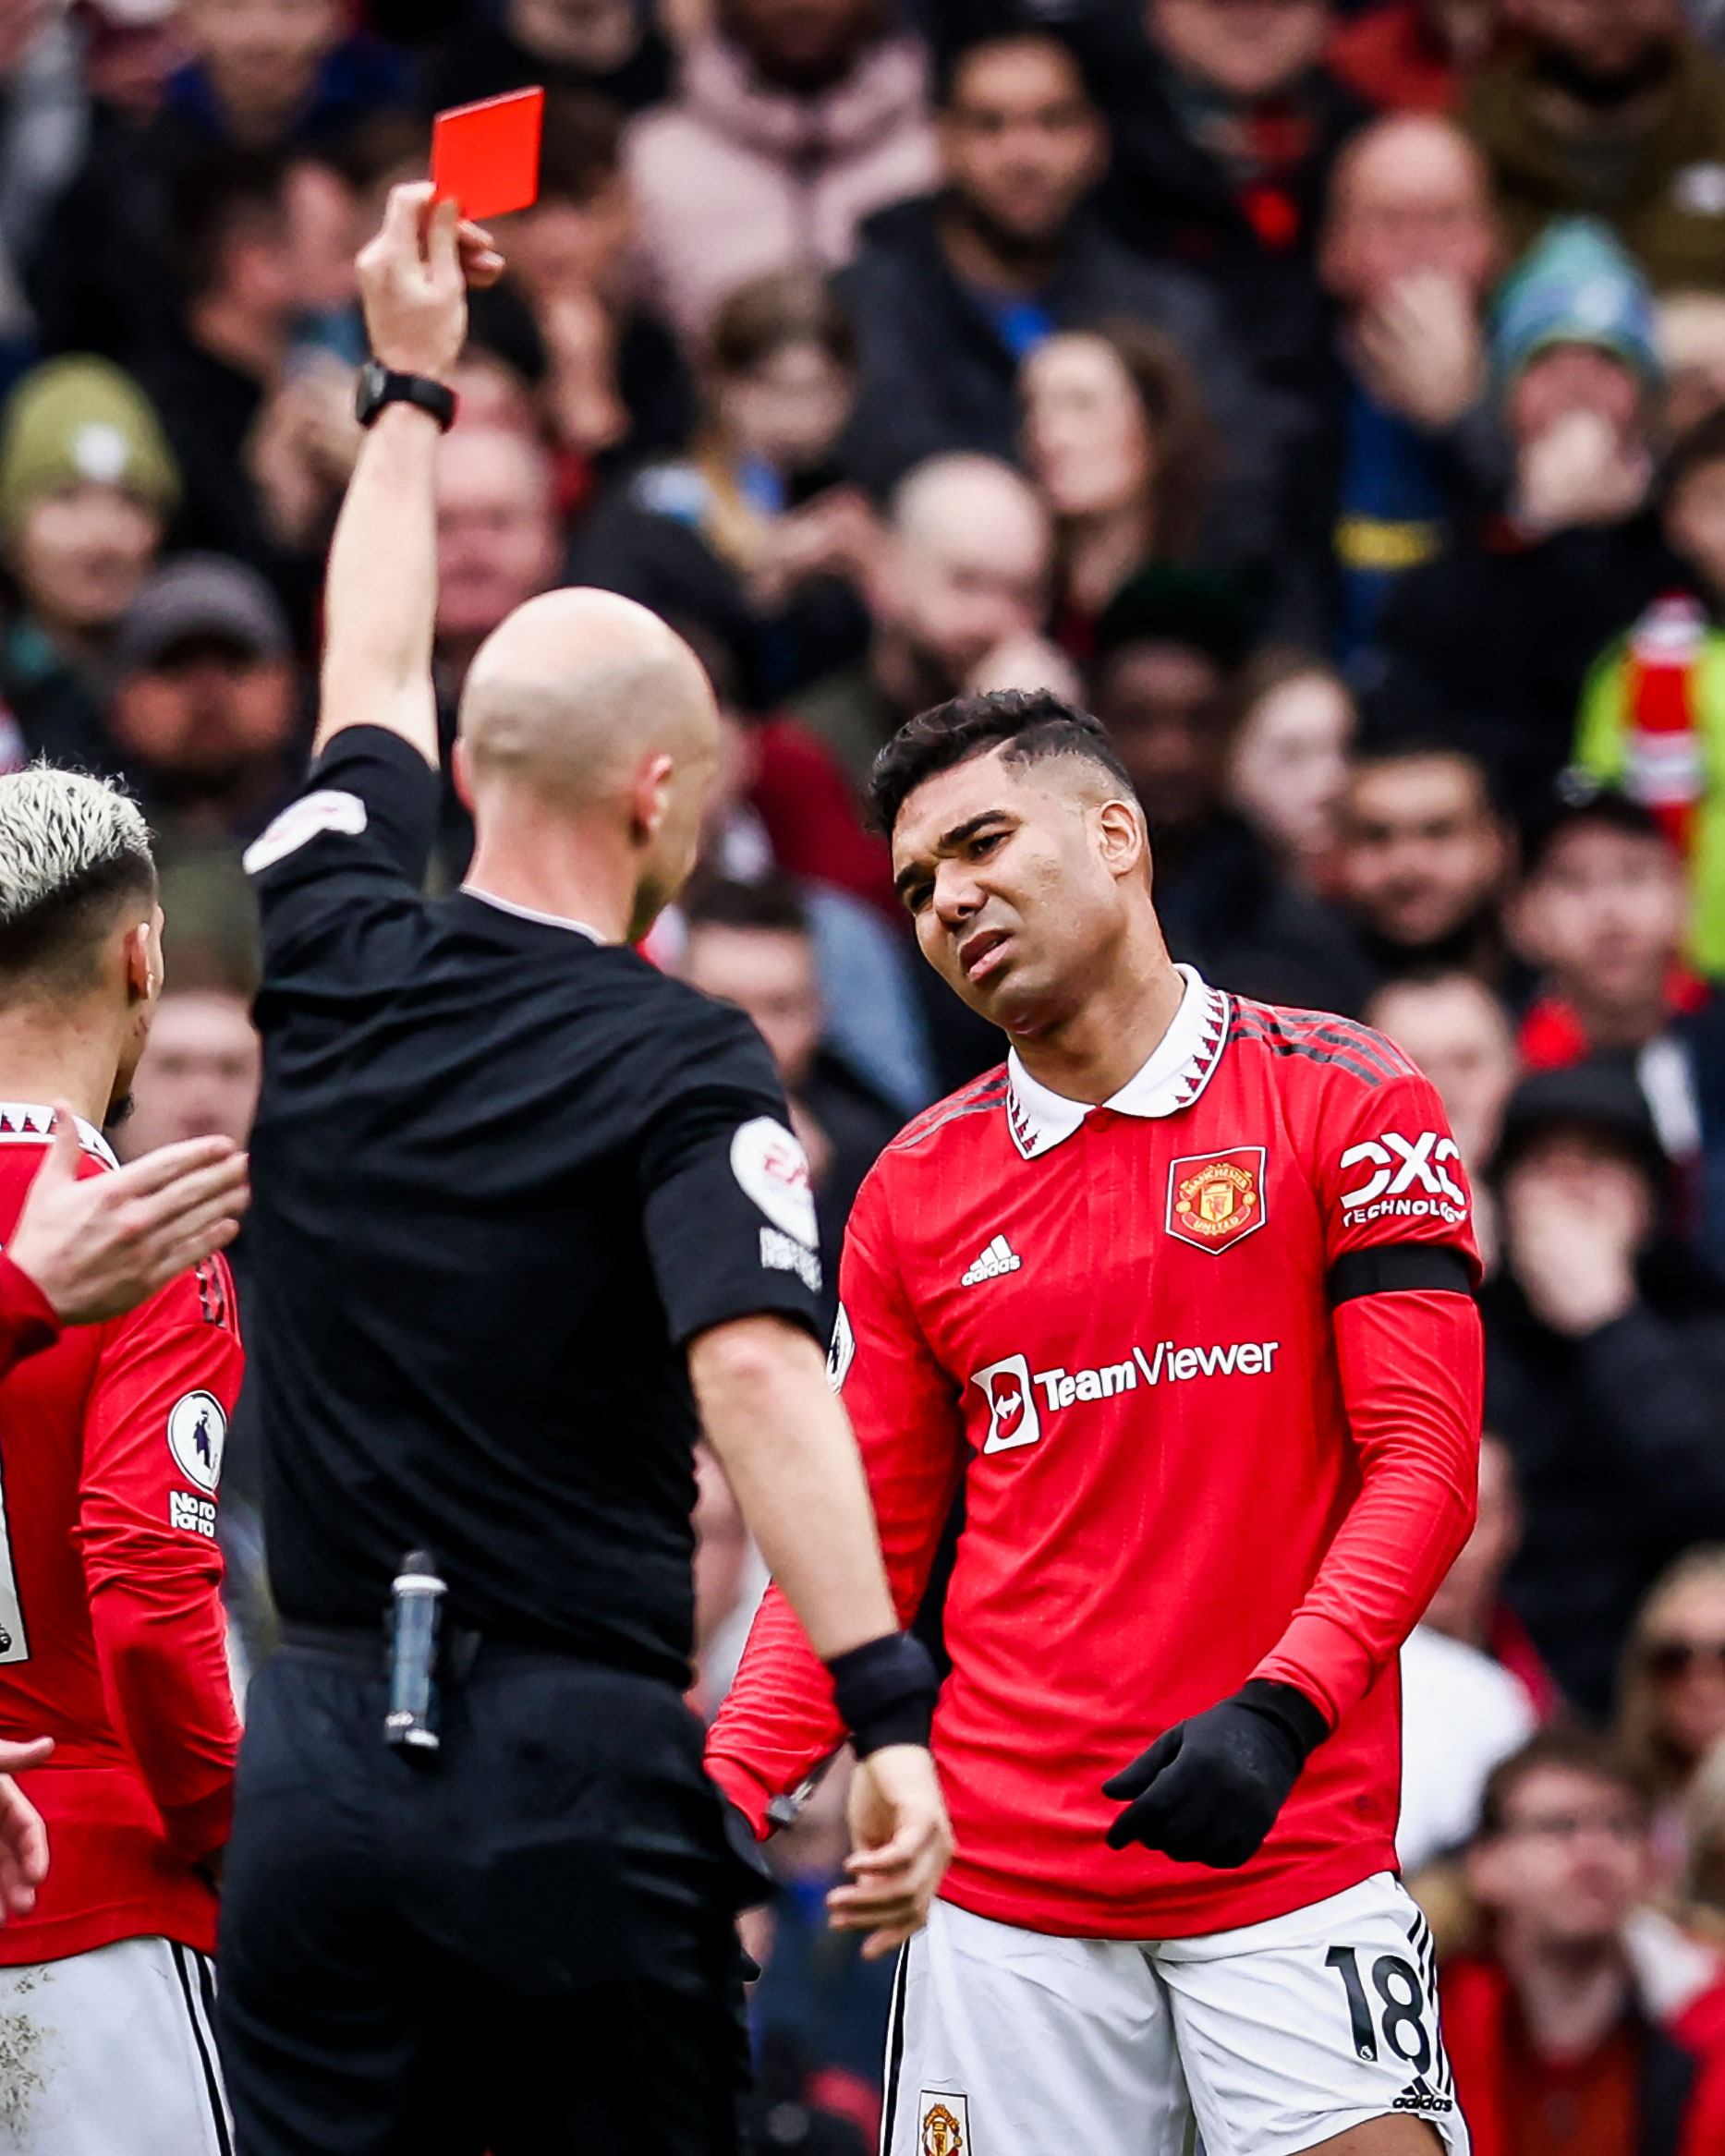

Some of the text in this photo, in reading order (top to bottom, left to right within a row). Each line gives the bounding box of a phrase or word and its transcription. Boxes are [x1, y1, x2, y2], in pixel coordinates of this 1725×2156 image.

[1193, 1216, 1240, 1231] UNITED
[961, 1254, 1021, 1287] adidas
[1033, 1341, 1279, 1411] TeamViewer
[1324, 1945, 1431, 2076] 18
[1392, 2093, 1453, 2113] adidas
